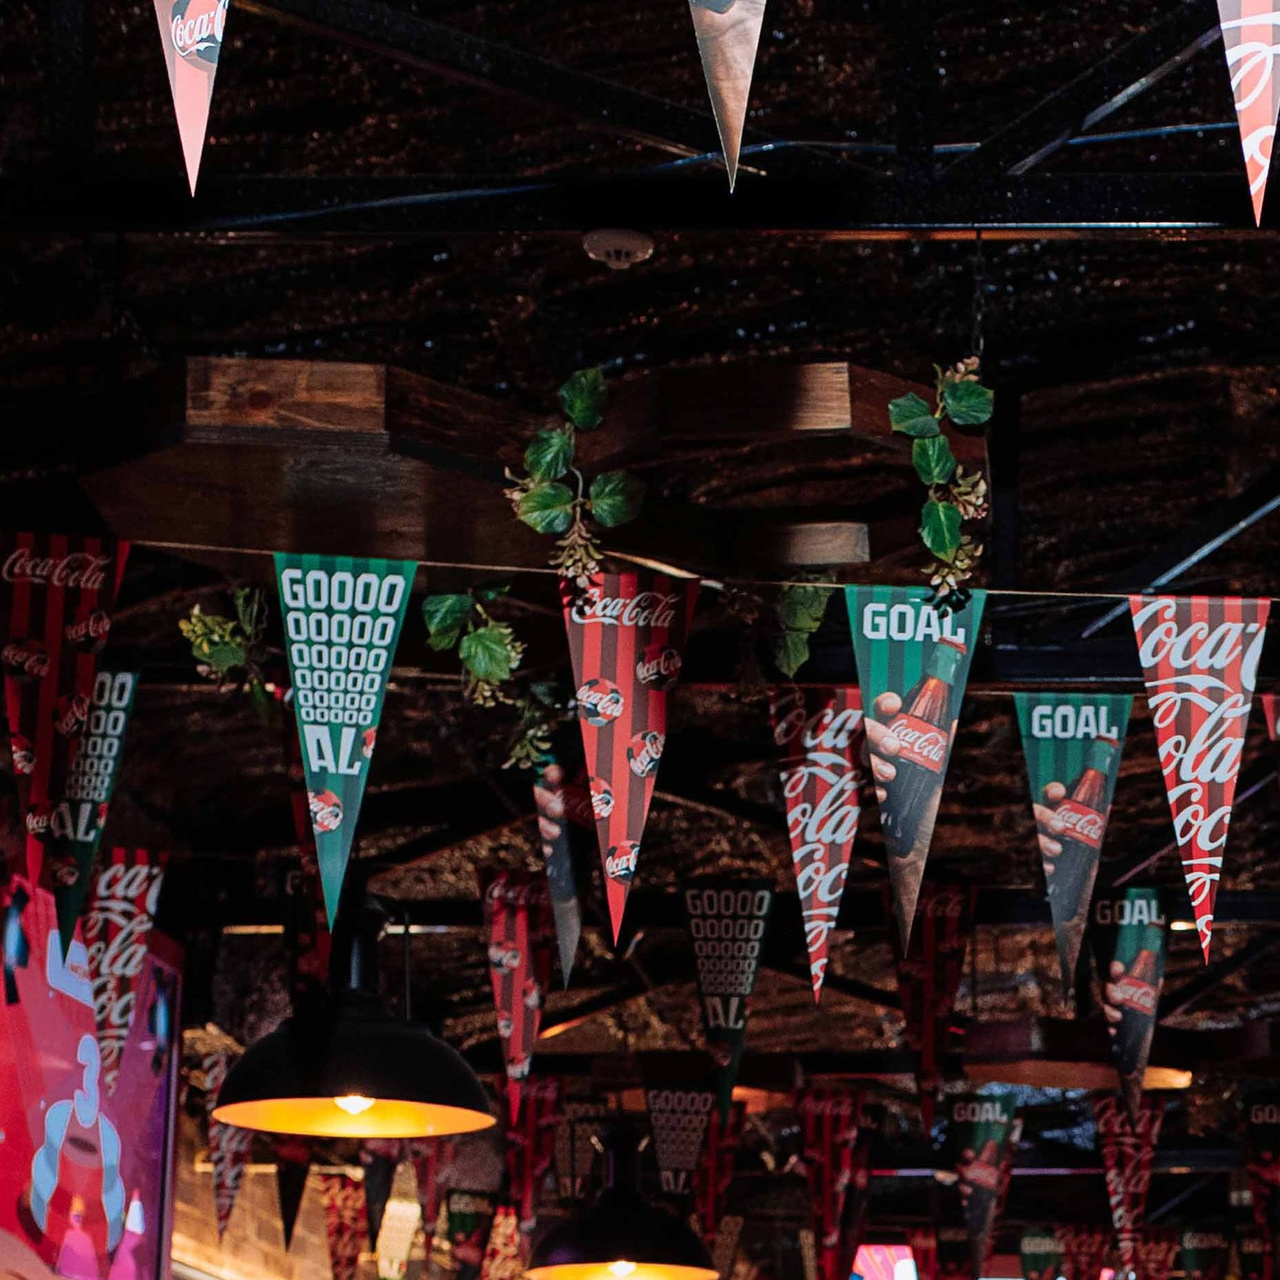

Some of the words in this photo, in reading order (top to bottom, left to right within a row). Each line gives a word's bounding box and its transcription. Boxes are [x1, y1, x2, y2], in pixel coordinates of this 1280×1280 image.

[2, 548, 112, 589] Coca-Cola
[281, 570, 405, 612] GOOOO
[286, 612, 398, 645] OOOOO
[863, 602, 966, 644] GOAL
[290, 645, 388, 671] OOOOO
[295, 670, 381, 692] OOOOO
[298, 690, 377, 710] OOOOO
[301, 707, 373, 726] OOOOO
[1031, 704, 1118, 740] GOAL
[304, 725, 361, 776] AL
[888, 718, 947, 763] Coca-Cola
[685, 889, 772, 916] GOOOO
[1095, 899, 1167, 926] GOAL
[705, 996, 745, 1030] AL
[953, 1102, 1009, 1124] GOAL
